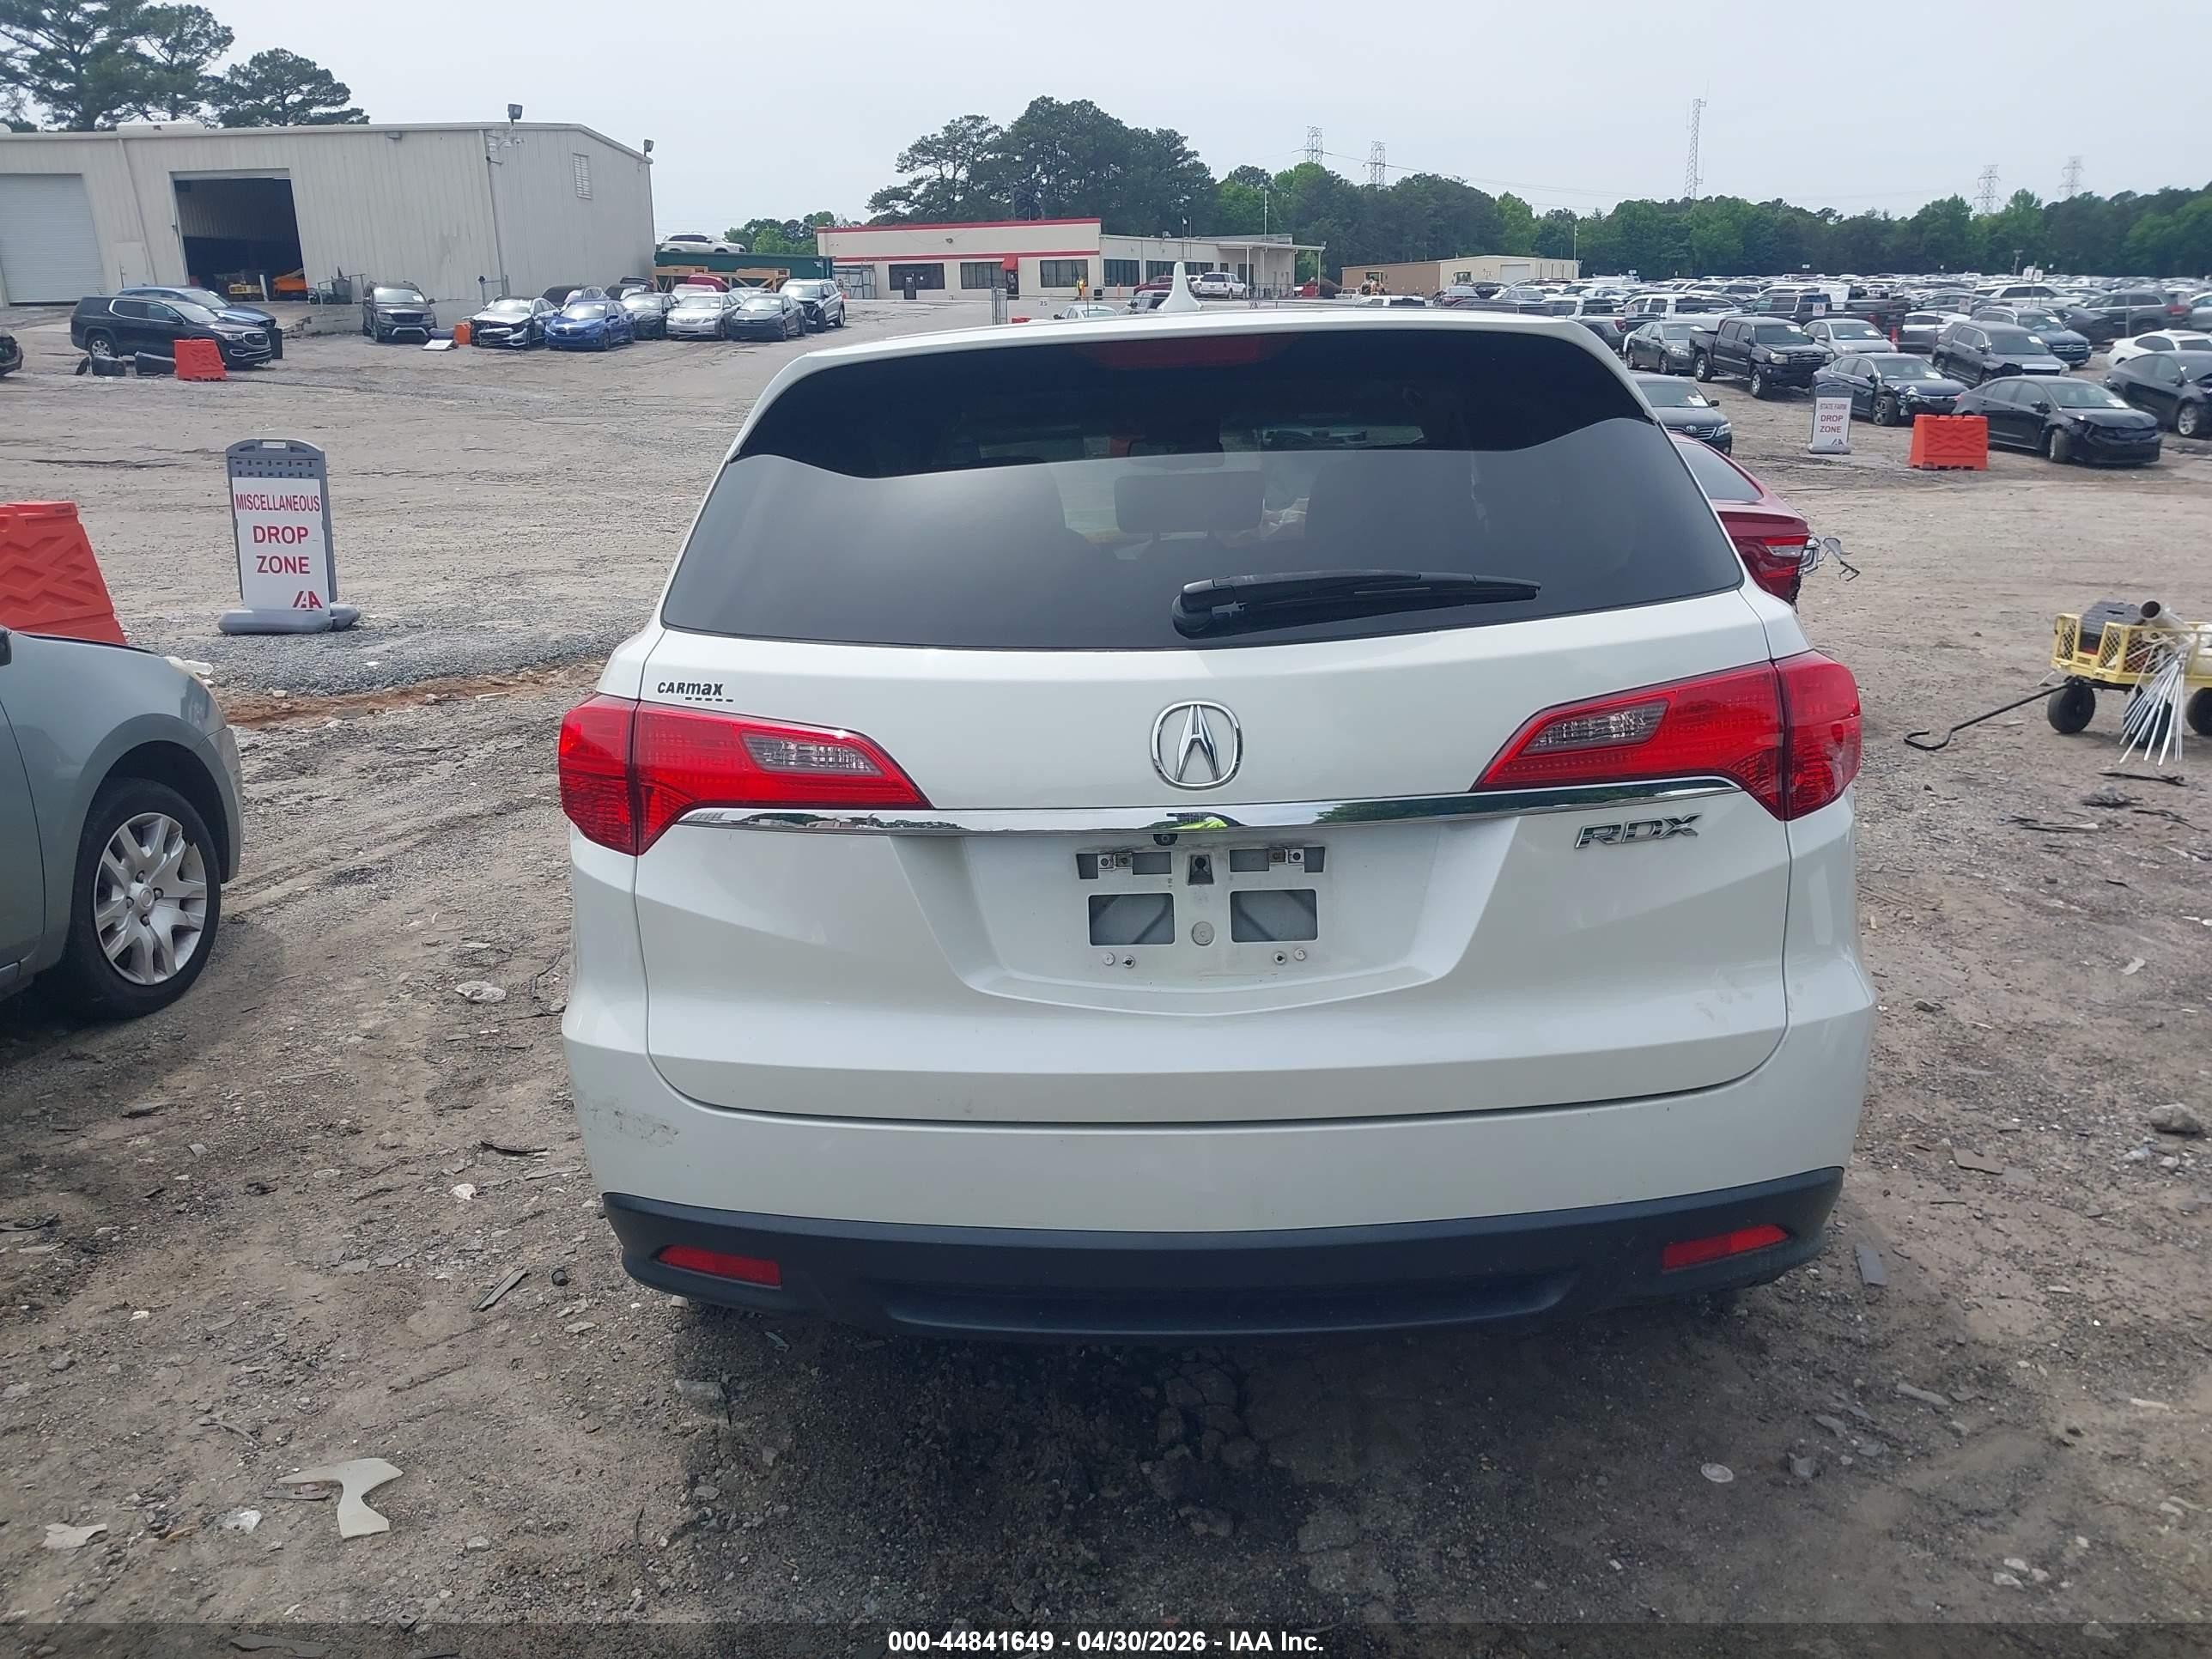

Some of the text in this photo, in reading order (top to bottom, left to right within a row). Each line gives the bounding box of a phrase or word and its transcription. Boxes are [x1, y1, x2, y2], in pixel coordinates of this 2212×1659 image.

[1820, 414, 1844, 422] DROP
[234, 493, 320, 513] MISCELLANEOUS
[252, 525, 309, 544] DROP
[255, 555, 311, 574] ZONE
[1574, 811, 1703, 849] RDX
